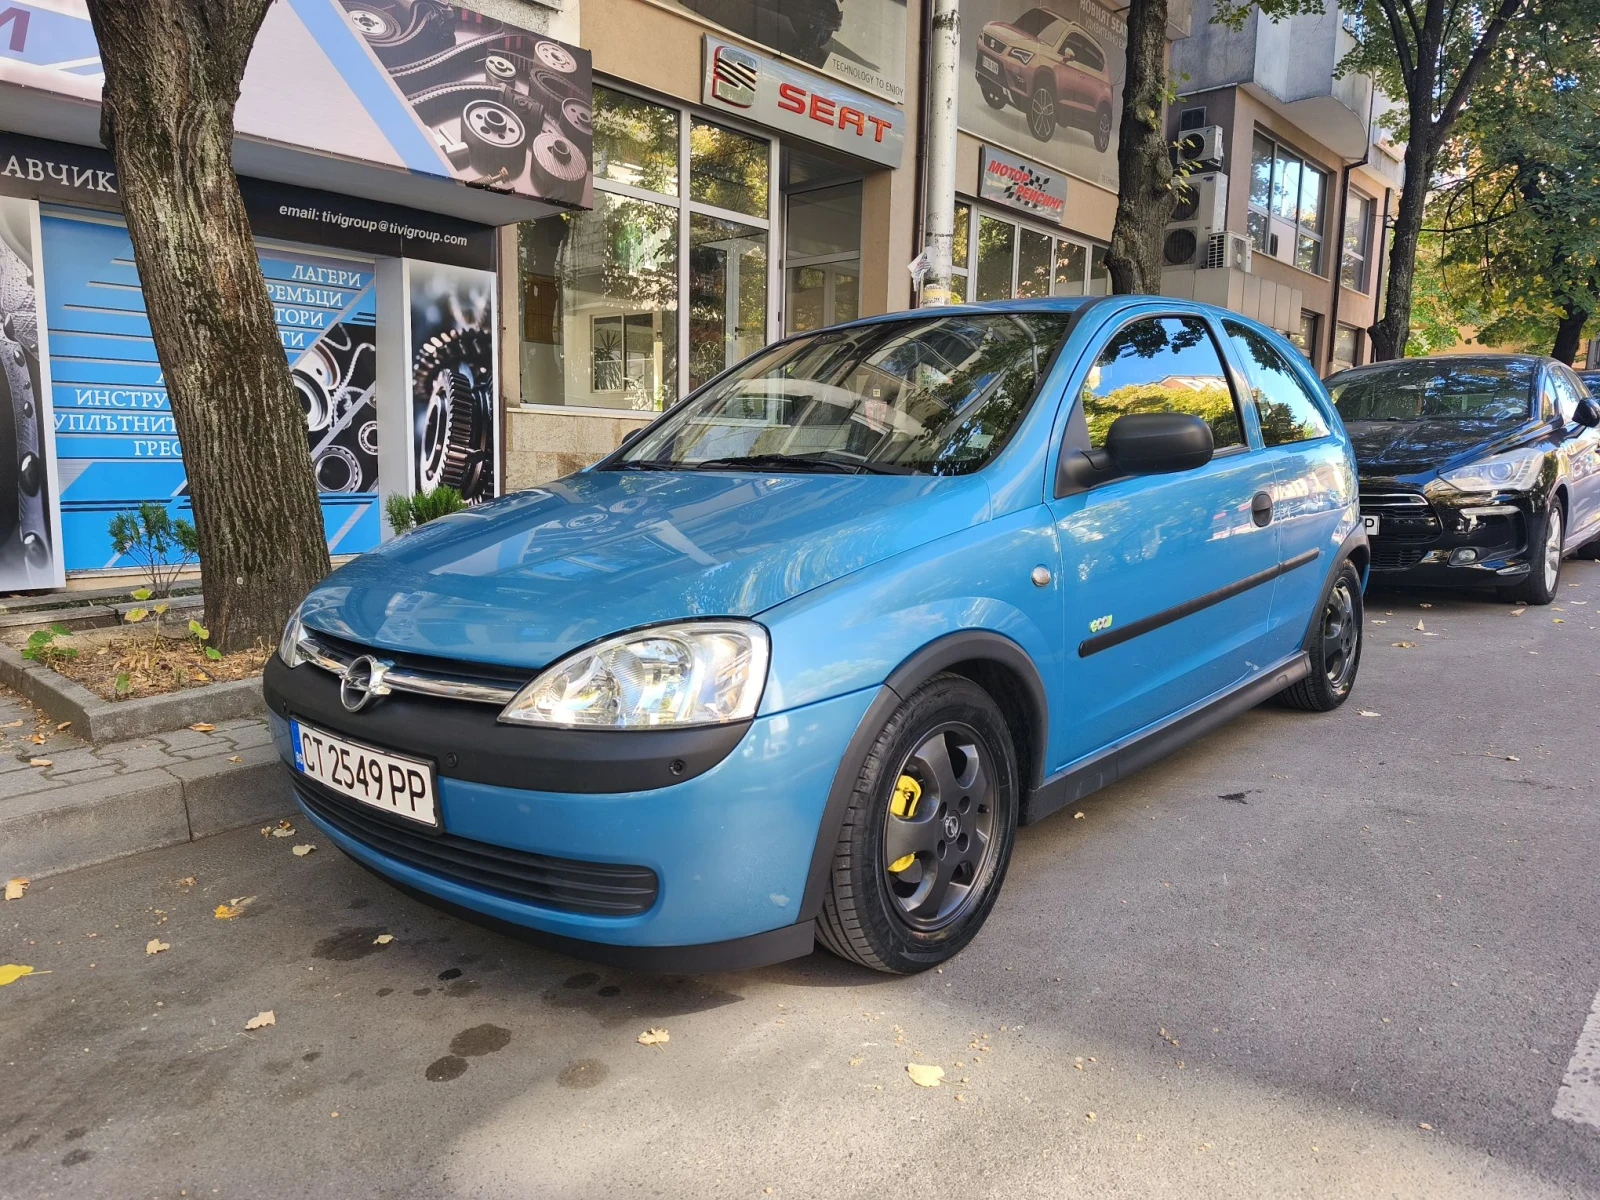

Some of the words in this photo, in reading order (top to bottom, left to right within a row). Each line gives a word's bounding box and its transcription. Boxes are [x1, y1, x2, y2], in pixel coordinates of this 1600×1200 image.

[832, 58, 874, 84] TECHNOLOGY
[876, 77, 885, 89] TO
[885, 82, 904, 96] ENJOY
[777, 82, 892, 143] SEAT
[1, 155, 117, 193] АВЧИК
[988, 159, 1031, 184] МОТОР
[279, 204, 319, 221] email:
[321, 210, 468, 247] tivigroup@tivigroup.com
[292, 265, 361, 287] ЛАГЕРИ
[266, 284, 343, 307] РЕМЪЦИ
[274, 308, 323, 327] ТОРИ
[75, 389, 170, 409] ИНСТРУ
[302, 732, 323, 777] CT
[328, 744, 383, 800] 2549
[388, 763, 426, 812] PP
